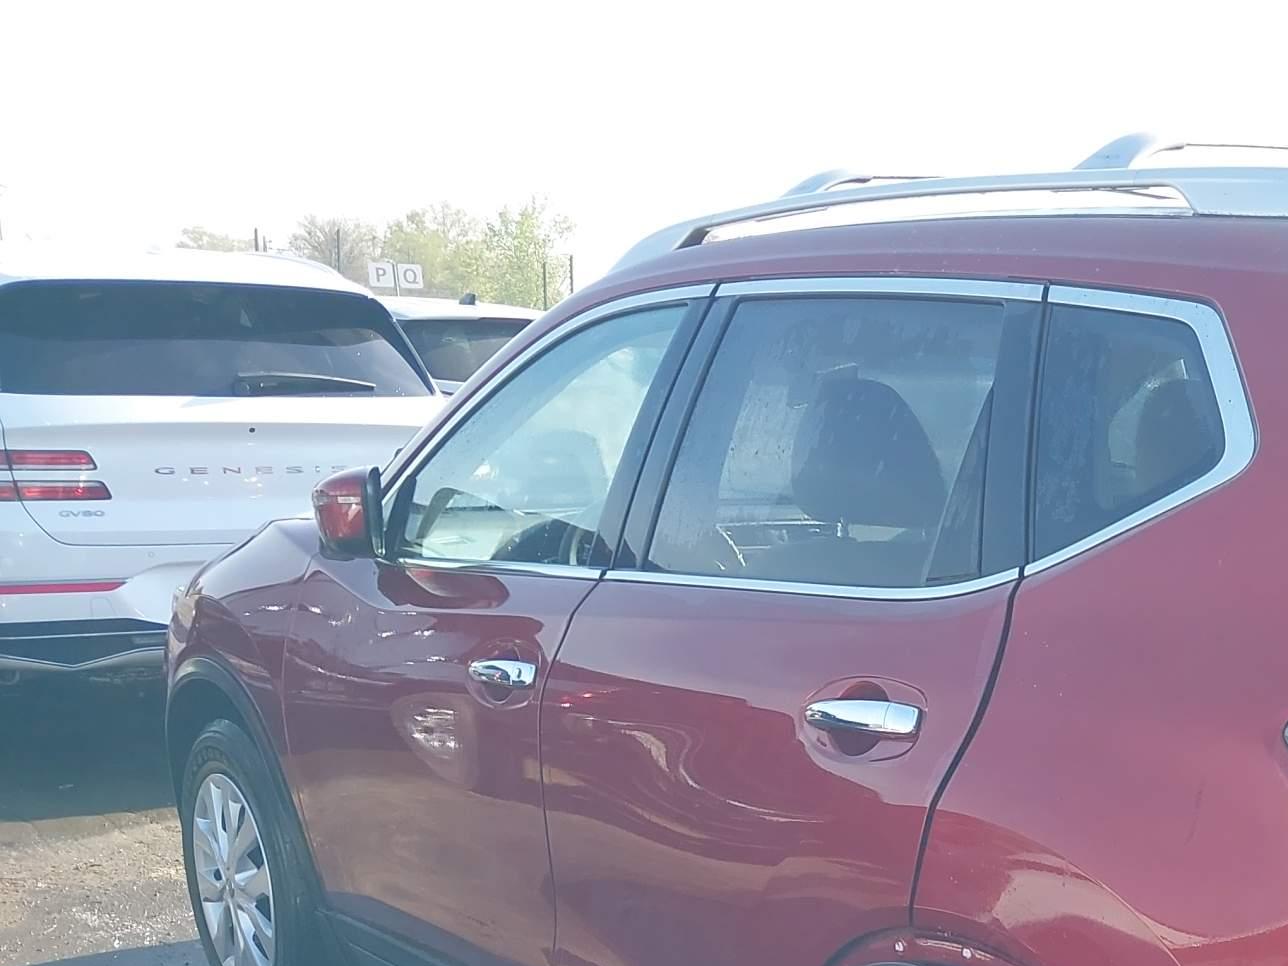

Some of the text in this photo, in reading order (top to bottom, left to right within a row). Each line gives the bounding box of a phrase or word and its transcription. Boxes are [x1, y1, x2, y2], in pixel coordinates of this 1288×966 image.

[375, 267, 387, 283] P
[403, 268, 419, 284] Q
[154, 465, 348, 475] GENESIS
[59, 510, 105, 518] GV80
